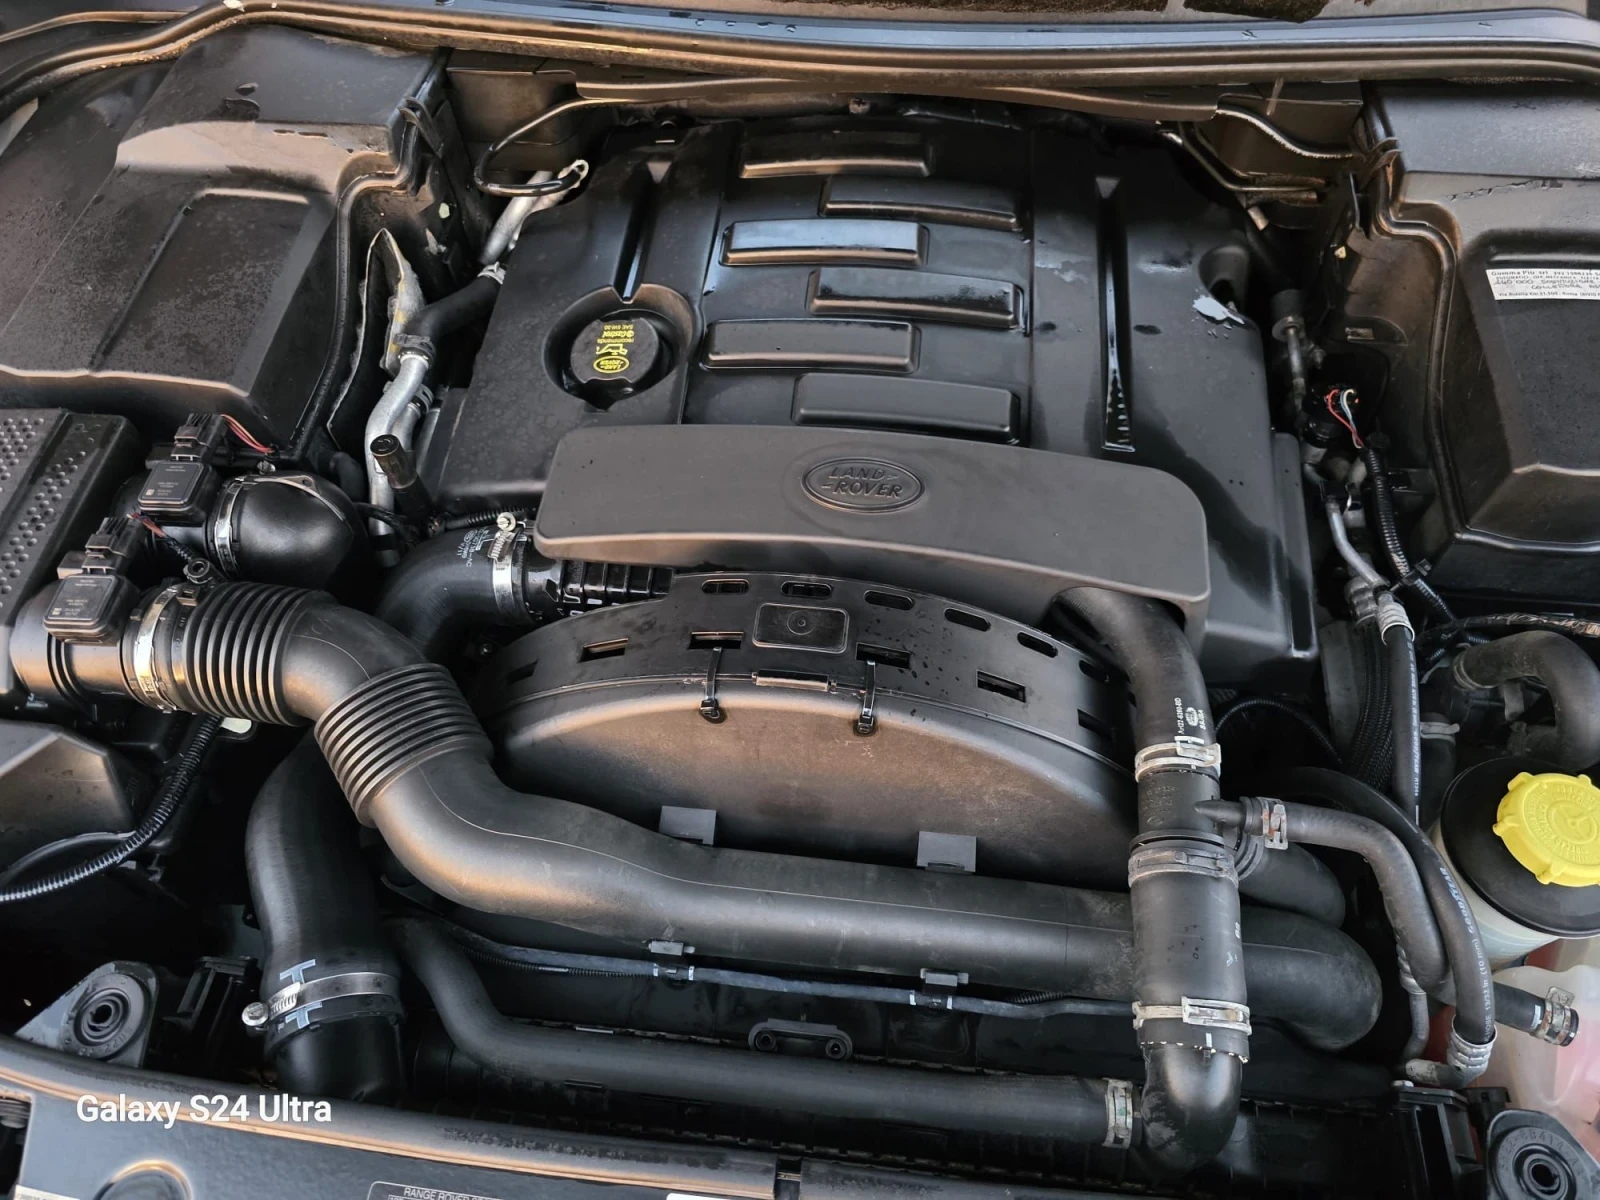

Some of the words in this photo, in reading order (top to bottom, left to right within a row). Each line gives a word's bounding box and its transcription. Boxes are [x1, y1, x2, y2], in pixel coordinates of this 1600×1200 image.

[828, 466, 885, 481] LAND
[832, 480, 903, 499] ROVER
[1440, 867, 1475, 934] GOODYEAR
[403, 1187, 437, 1200] RANGE
